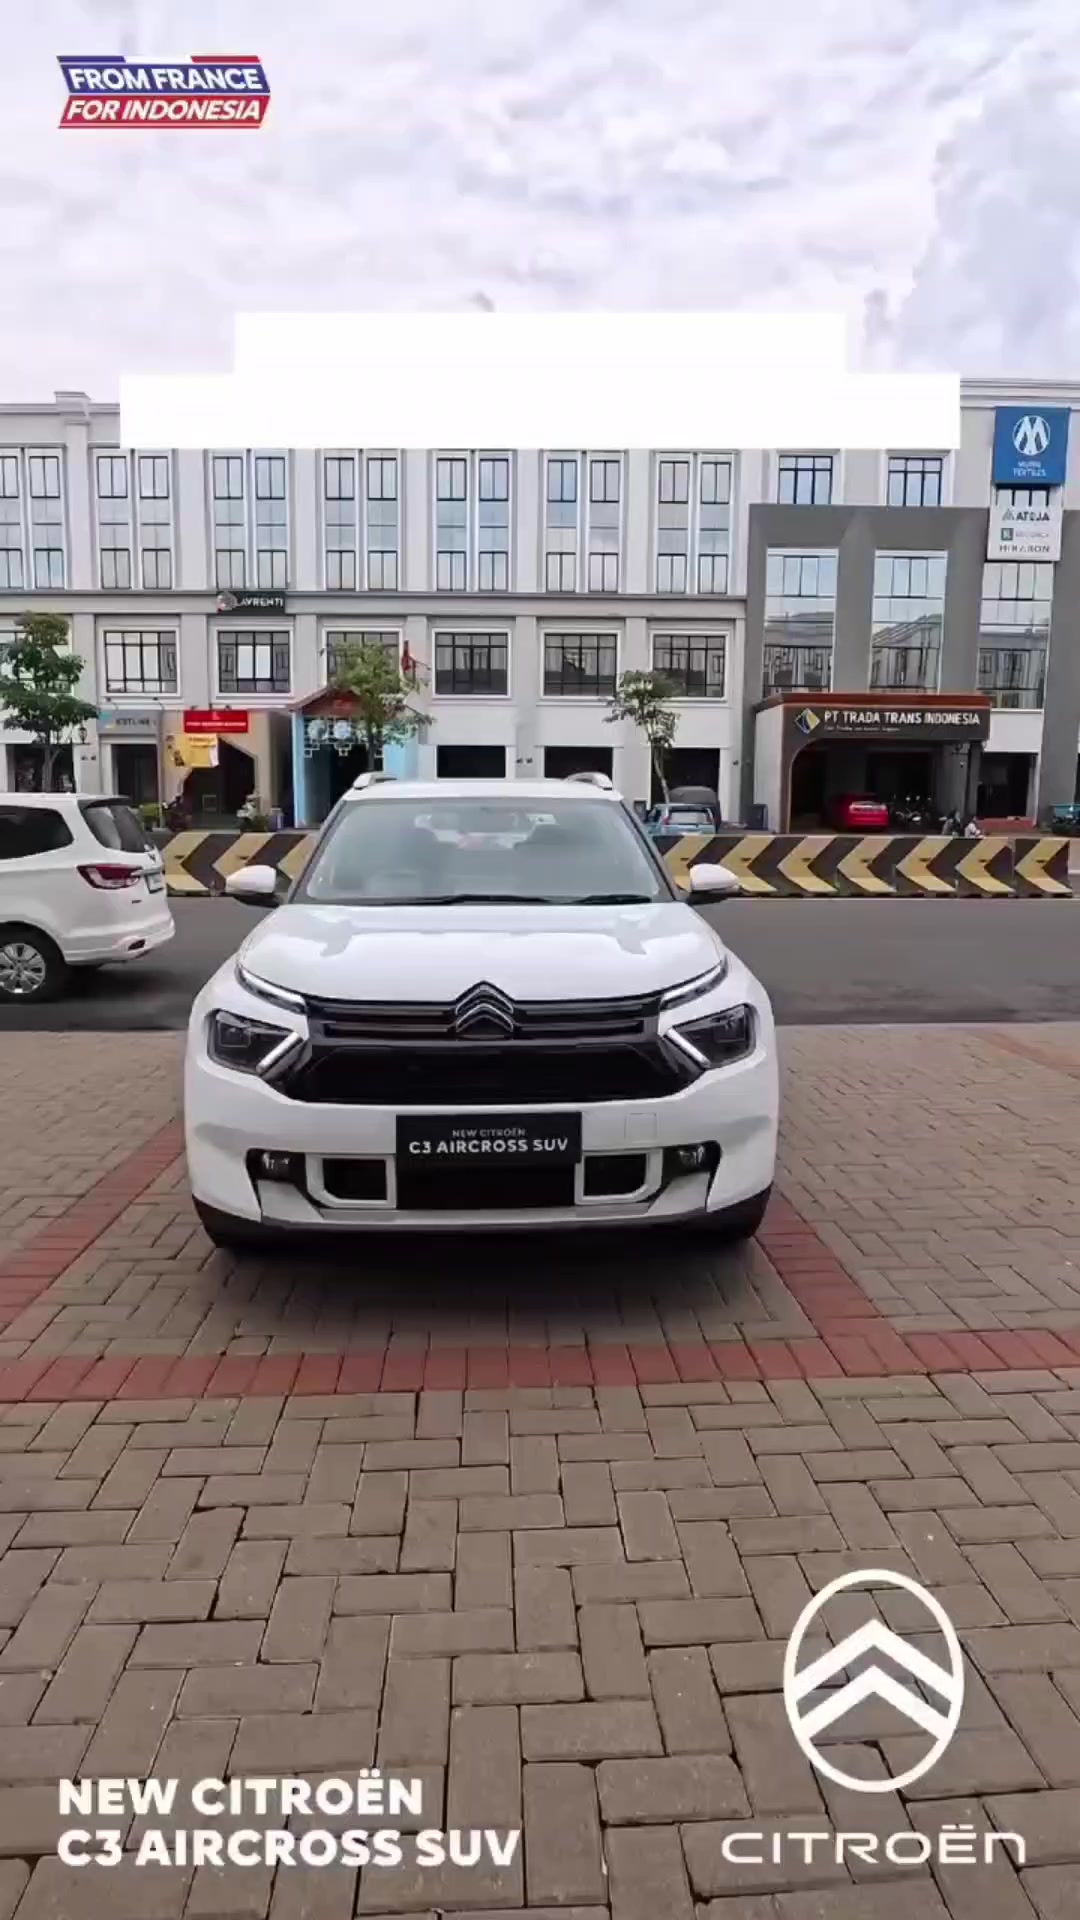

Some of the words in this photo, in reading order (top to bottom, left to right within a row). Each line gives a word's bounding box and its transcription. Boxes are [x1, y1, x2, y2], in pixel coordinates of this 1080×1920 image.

[824, 711, 838, 723] PT
[842, 711, 880, 723] TRADA
[884, 712, 921, 724] TRANS
[924, 712, 981, 725] INDONESIA
[452, 1129, 477, 1138] NEW
[409, 1141, 431, 1154] C3
[436, 1139, 528, 1153] AIRCROSS
[533, 1138, 568, 1151] SUV
